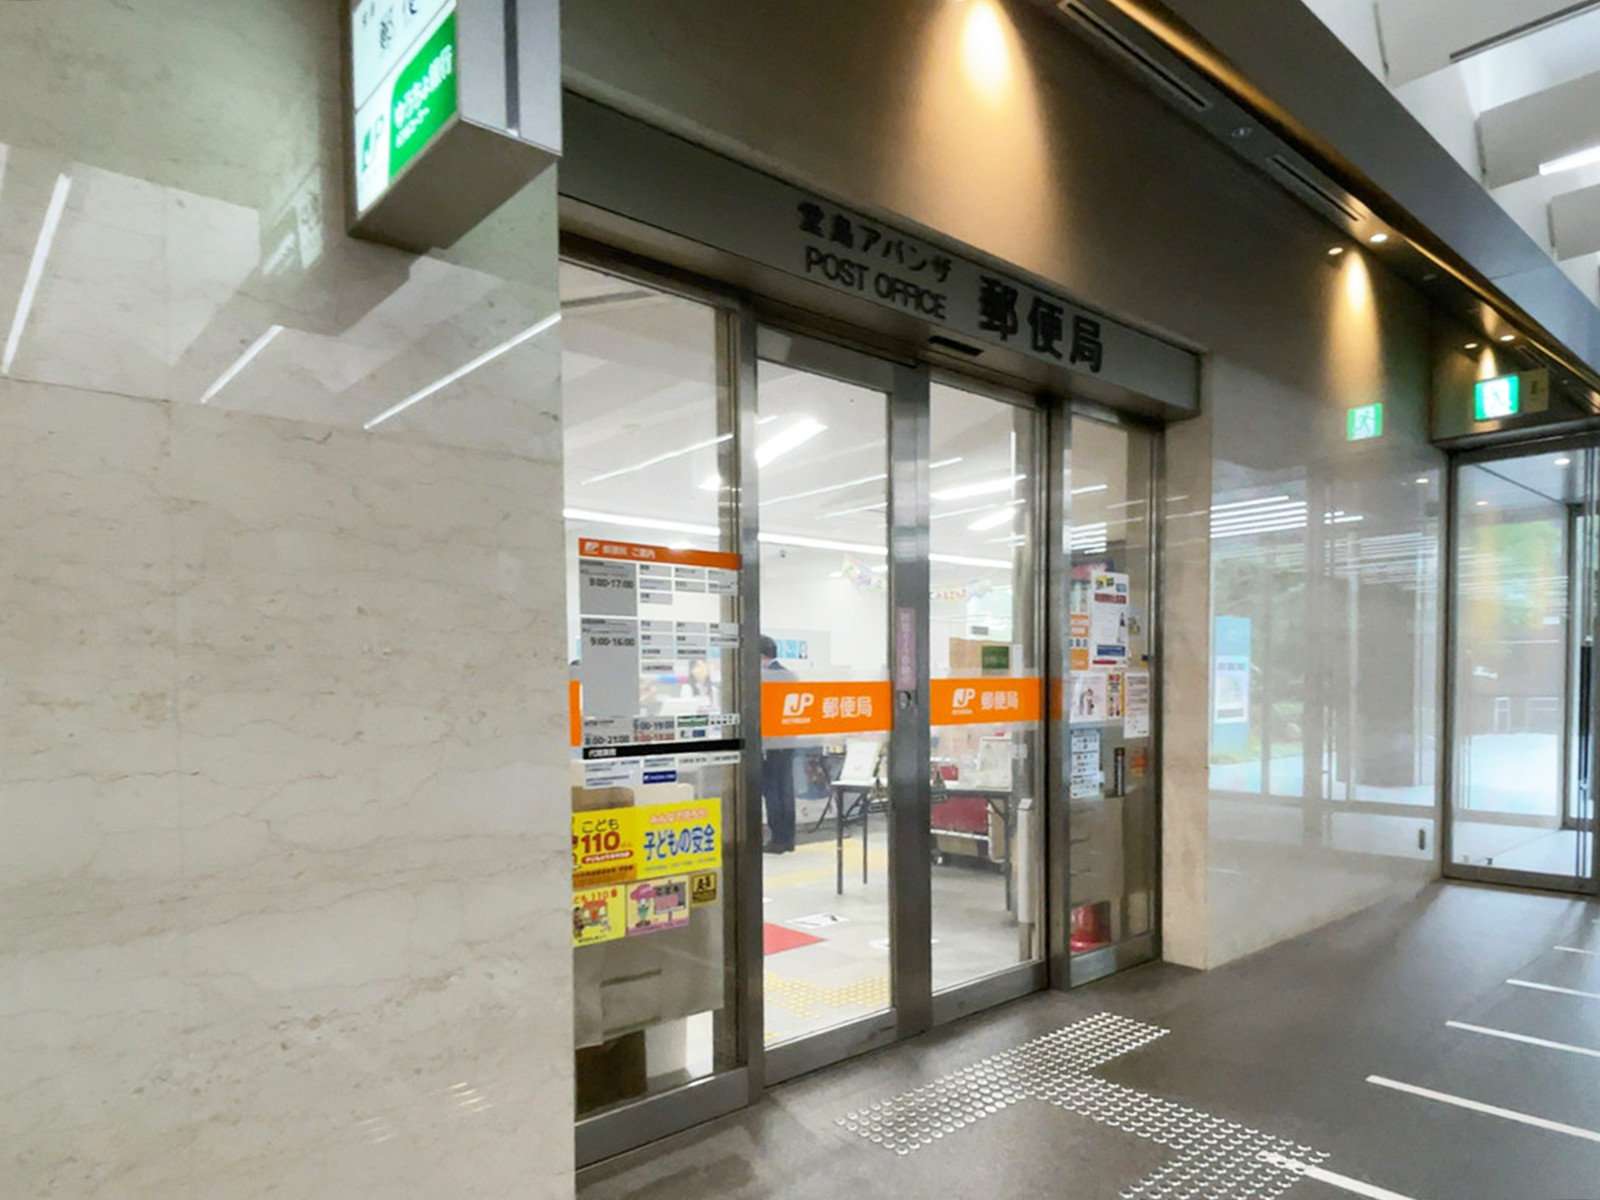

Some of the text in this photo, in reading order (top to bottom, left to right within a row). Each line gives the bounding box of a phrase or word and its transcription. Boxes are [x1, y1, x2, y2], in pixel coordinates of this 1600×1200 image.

[805, 246, 947, 321] POST OFFICE
[978, 275, 1103, 374] 郵便局
[782, 693, 872, 718] JP 郵便局
[952, 688, 1019, 710] JP 郵便局
[582, 818, 619, 833] こども
[581, 831, 620, 853] 110
[643, 824, 715, 861] 子どもの安全
